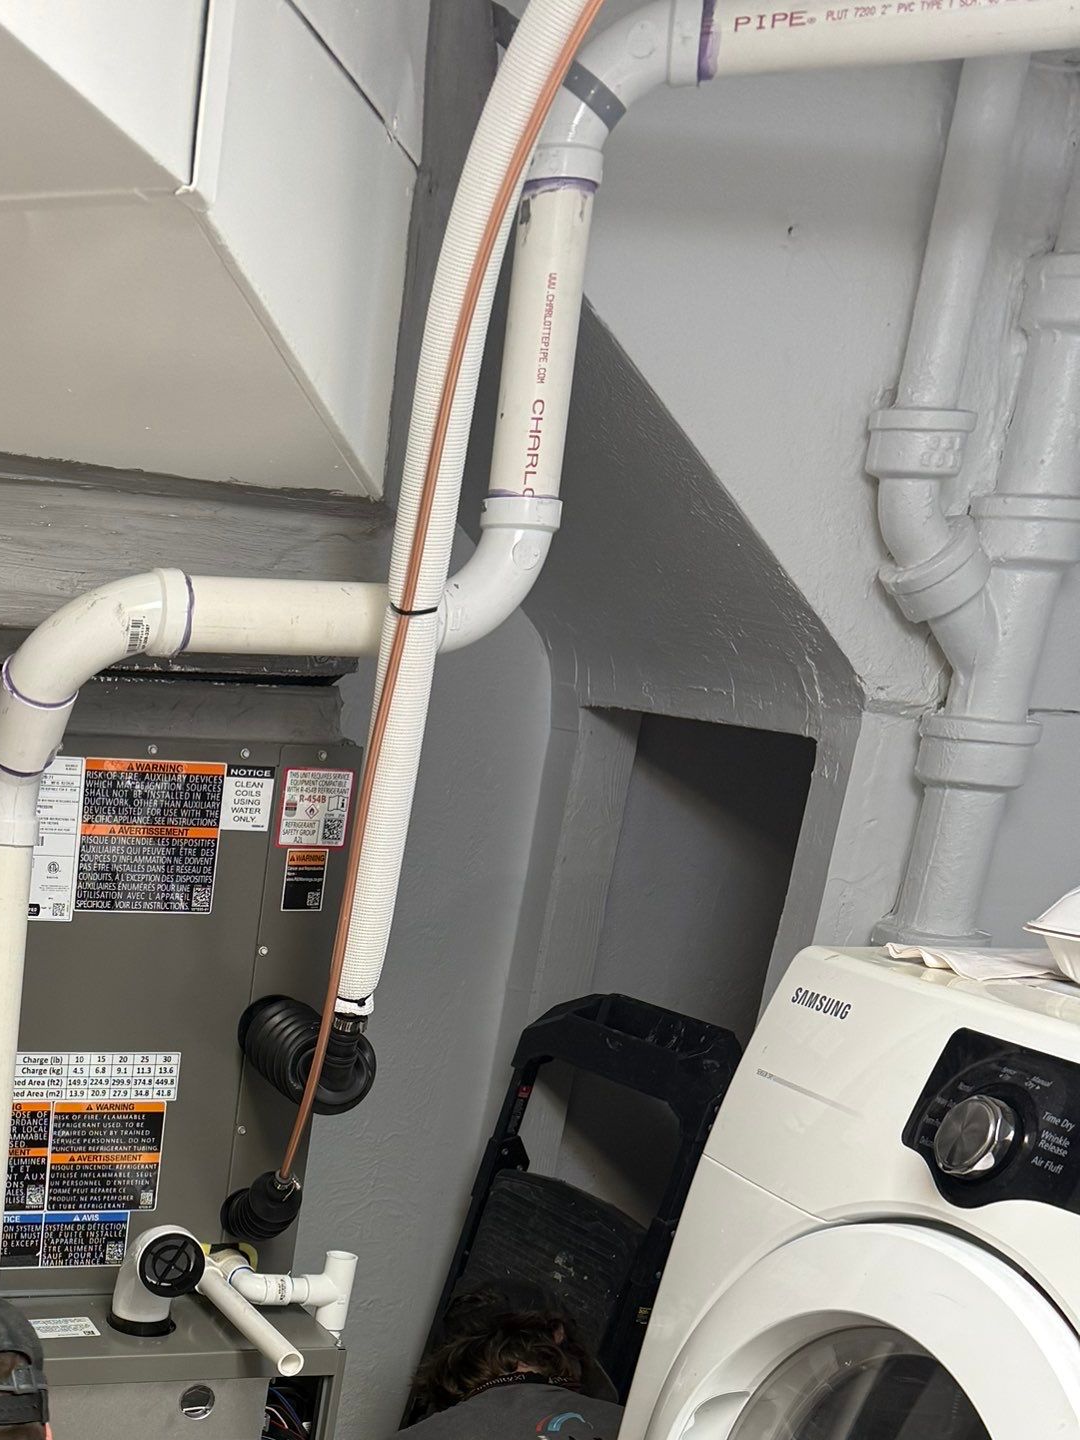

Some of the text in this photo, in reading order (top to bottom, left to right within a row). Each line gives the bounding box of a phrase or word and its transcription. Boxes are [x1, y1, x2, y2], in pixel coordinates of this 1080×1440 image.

[896, 2, 915, 13] PVC
[537, 273, 557, 384] WWW.CHARLOTTEPIPE.COM
[135, 763, 183, 773] WARNING
[231, 768, 271, 777] NOTICE
[87, 771, 103, 779] RISK
[145, 773, 187, 782] AUXILIARY
[189, 775, 222, 783] DEVICES
[86, 780, 221, 793] WHICH SOURCES
[85, 789, 112, 797] SHALL
[113, 790, 128, 798] NOT
[206, 793, 220, 801] THE
[299, 795, 326, 804] R-454B
[134, 799, 158, 808] OTHER
[160, 800, 180, 808] THAN
[183, 801, 220, 809] AUXILIARY
[84, 806, 220, 818] DEVICES LISTED FOR USE WITH THE
[154, 817, 166, 825] SEE
[118, 827, 190, 836] AVERTISSEMENT
[81, 836, 215, 847] RISQUE LES DISPOSITIFS
[81, 845, 124, 854] AUXILIAIRES
[127, 847, 140, 856] QUI
[143, 848, 175, 856] PEUVENT
[791, 987, 851, 1020] SAMSUNG
[23, 1056, 49, 1065] Charge
[50, 1056, 63, 1065] (lb)
[21, 1067, 48, 1075] Charge
[49, 1067, 63, 1075] (kg)
[45, 1090, 63, 1098] (m2)
[1042, 1111, 1075, 1132] Time Dry
[1042, 1130, 1070, 1148] Wrinkle
[1038, 1140, 1068, 1157] Release
[1031, 1155, 1064, 1174] Air Fluff
